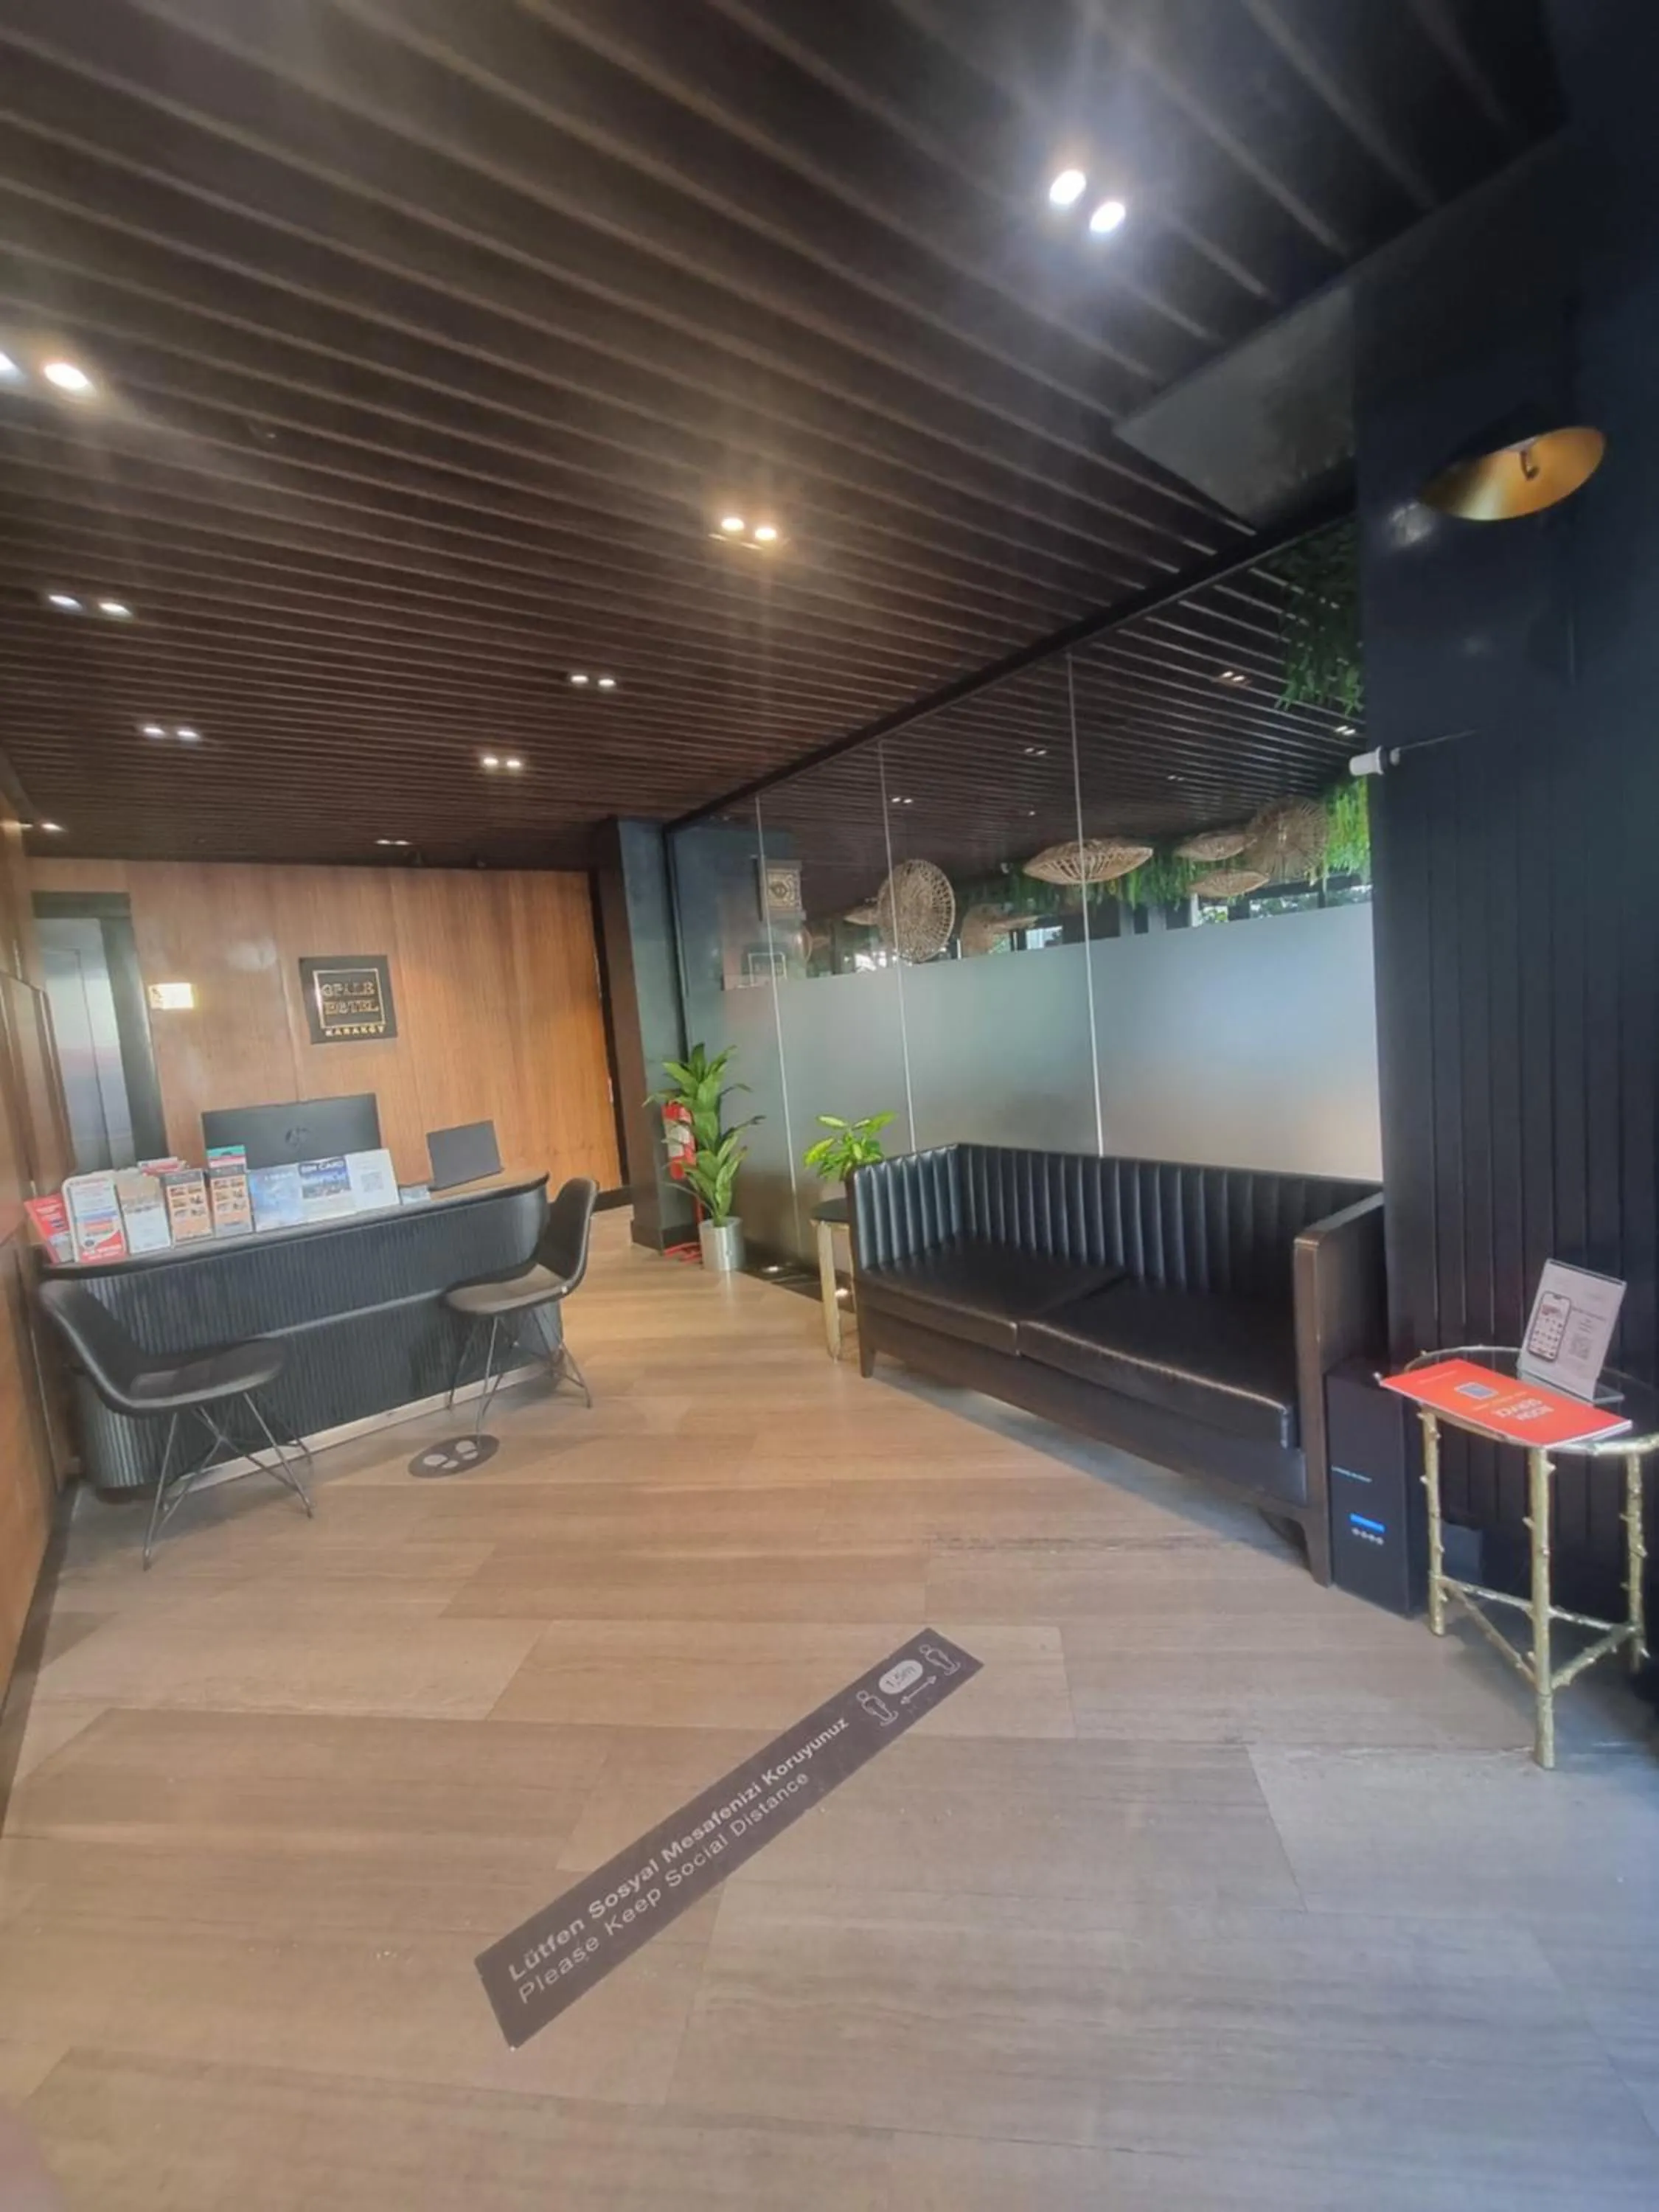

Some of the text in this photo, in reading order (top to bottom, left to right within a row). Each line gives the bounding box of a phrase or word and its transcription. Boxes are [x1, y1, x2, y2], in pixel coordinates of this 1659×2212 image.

[508, 1717, 850, 1982] Lütfen Sosyal Mesafenizi Koruyunuz
[518, 1773, 810, 2005] Please Keep Social Distance
